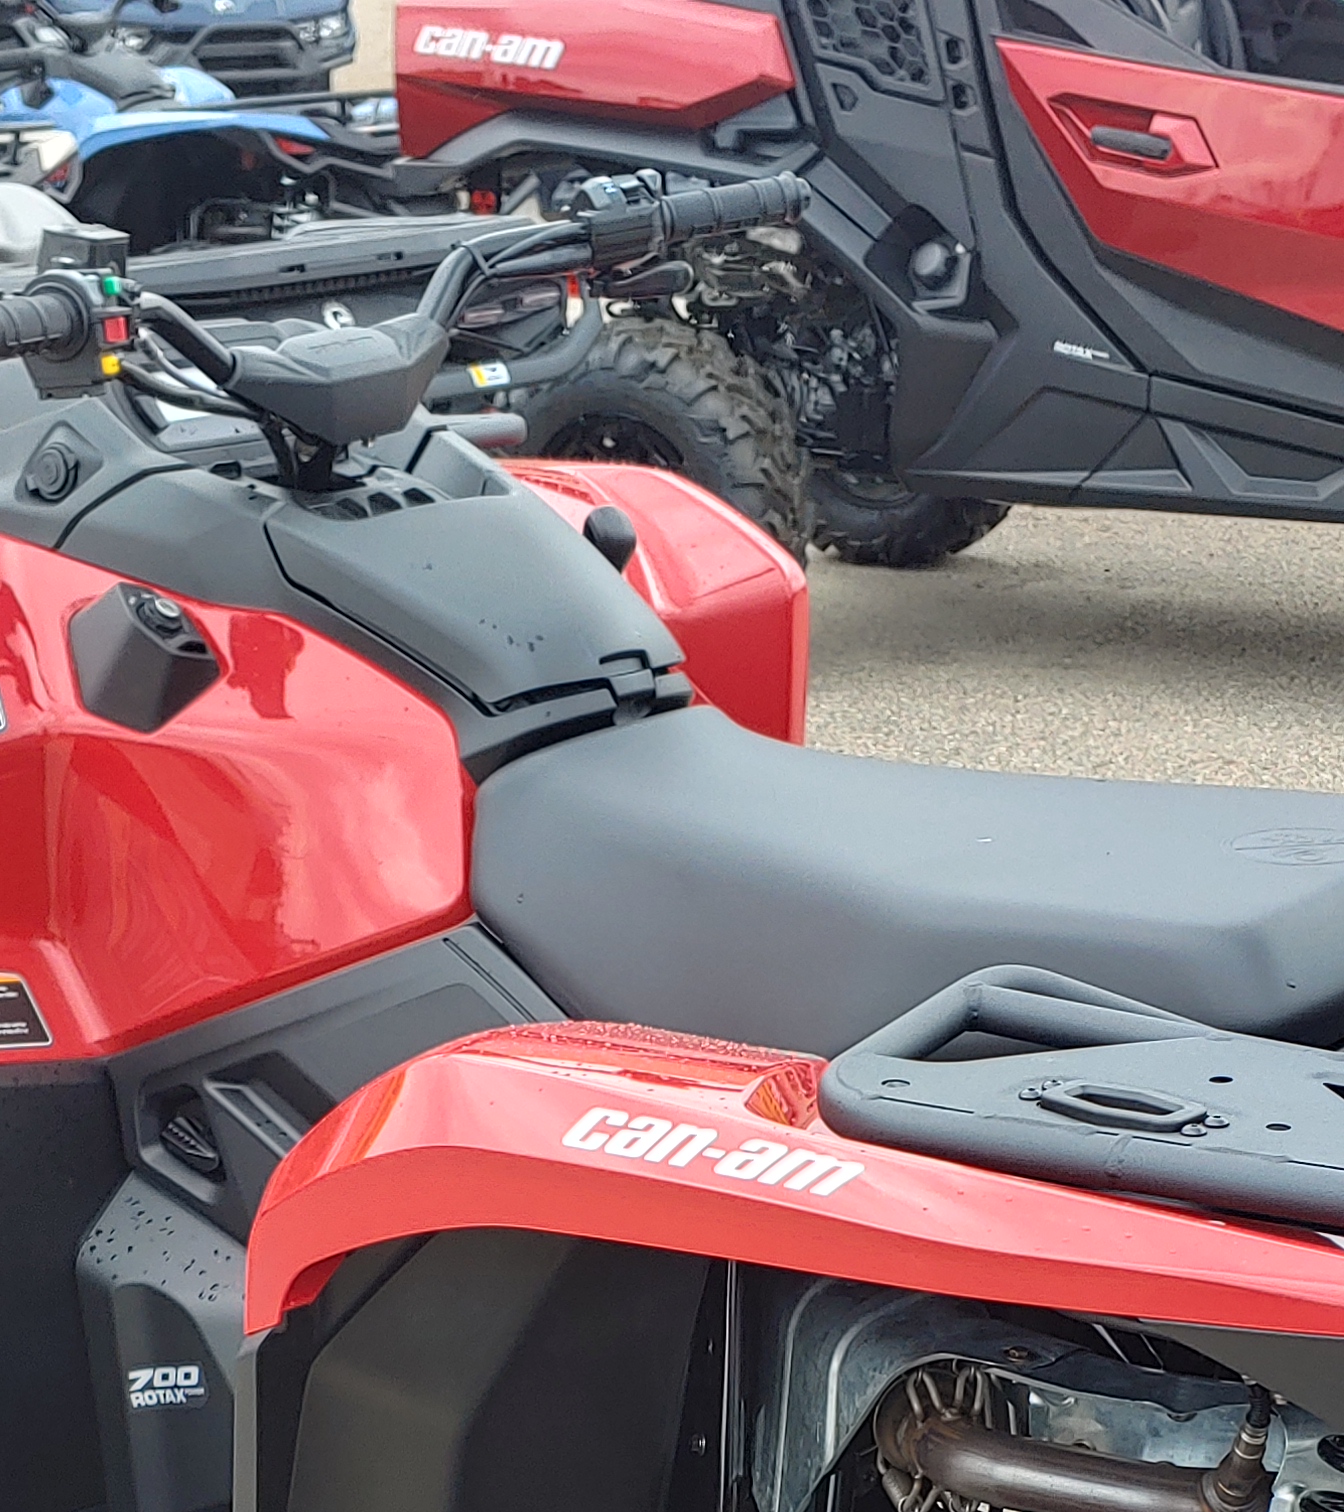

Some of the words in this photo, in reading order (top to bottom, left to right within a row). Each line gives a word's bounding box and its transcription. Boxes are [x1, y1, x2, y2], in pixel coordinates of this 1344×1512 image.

[413, 24, 565, 71] can-am
[561, 1106, 865, 1197] can-am
[128, 1365, 200, 1392] 700
[129, 1387, 187, 1409] ROTAX
